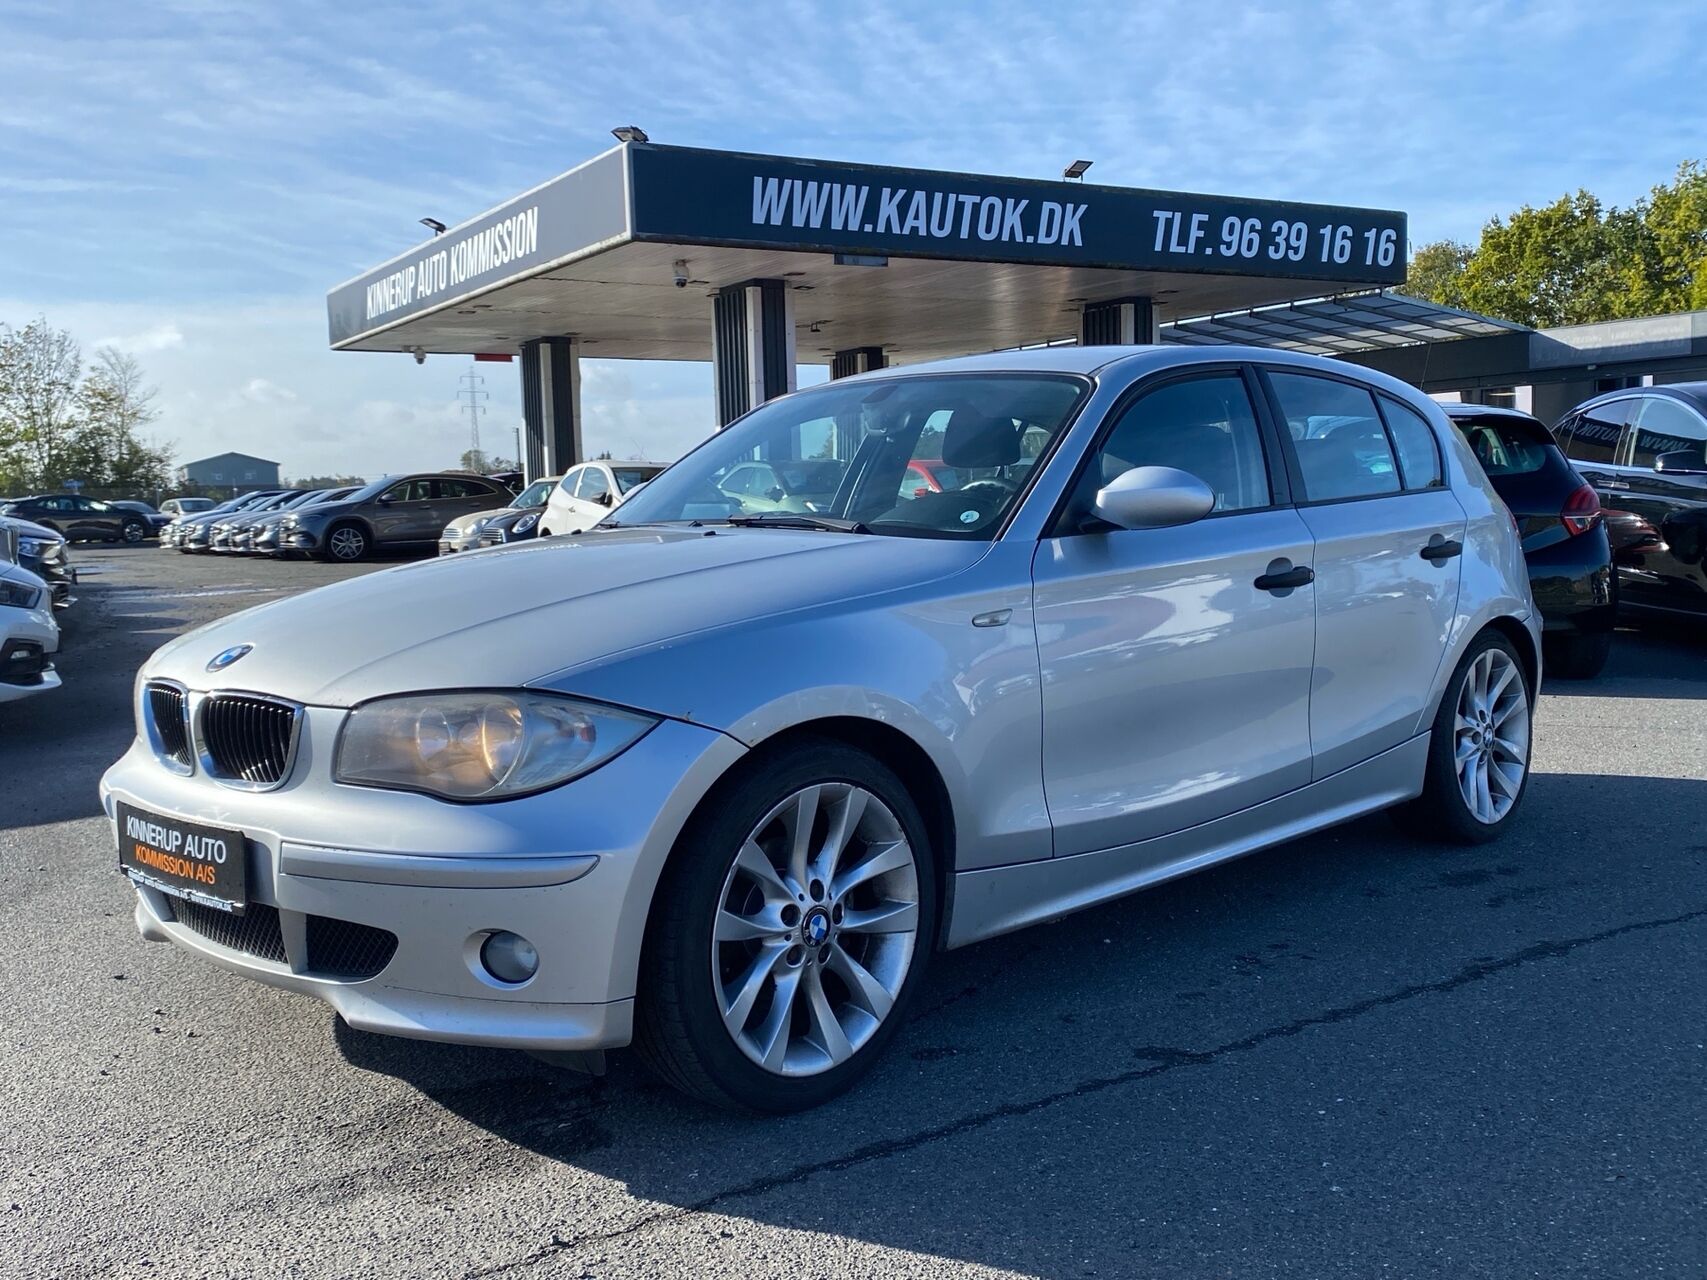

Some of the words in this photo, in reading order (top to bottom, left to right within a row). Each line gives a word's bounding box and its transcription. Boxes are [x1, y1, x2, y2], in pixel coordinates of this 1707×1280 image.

[752, 176, 1088, 247] WWW.KAUTOK.DK
[1153, 210, 1212, 255] TLF.
[1219, 216, 1262, 259] 96
[1268, 220, 1308, 262] 39
[1319, 224, 1353, 264] 16
[1364, 227, 1397, 267] 16
[366, 265, 415, 320] KINNERUP
[417, 250, 447, 299] AUTO
[450, 206, 538, 286] KOMMISSION
[127, 815, 182, 852] KINNERUP
[184, 834, 226, 864] AUTO
[135, 844, 194, 879] KOMMISSION
[196, 863, 216, 884] A/S
